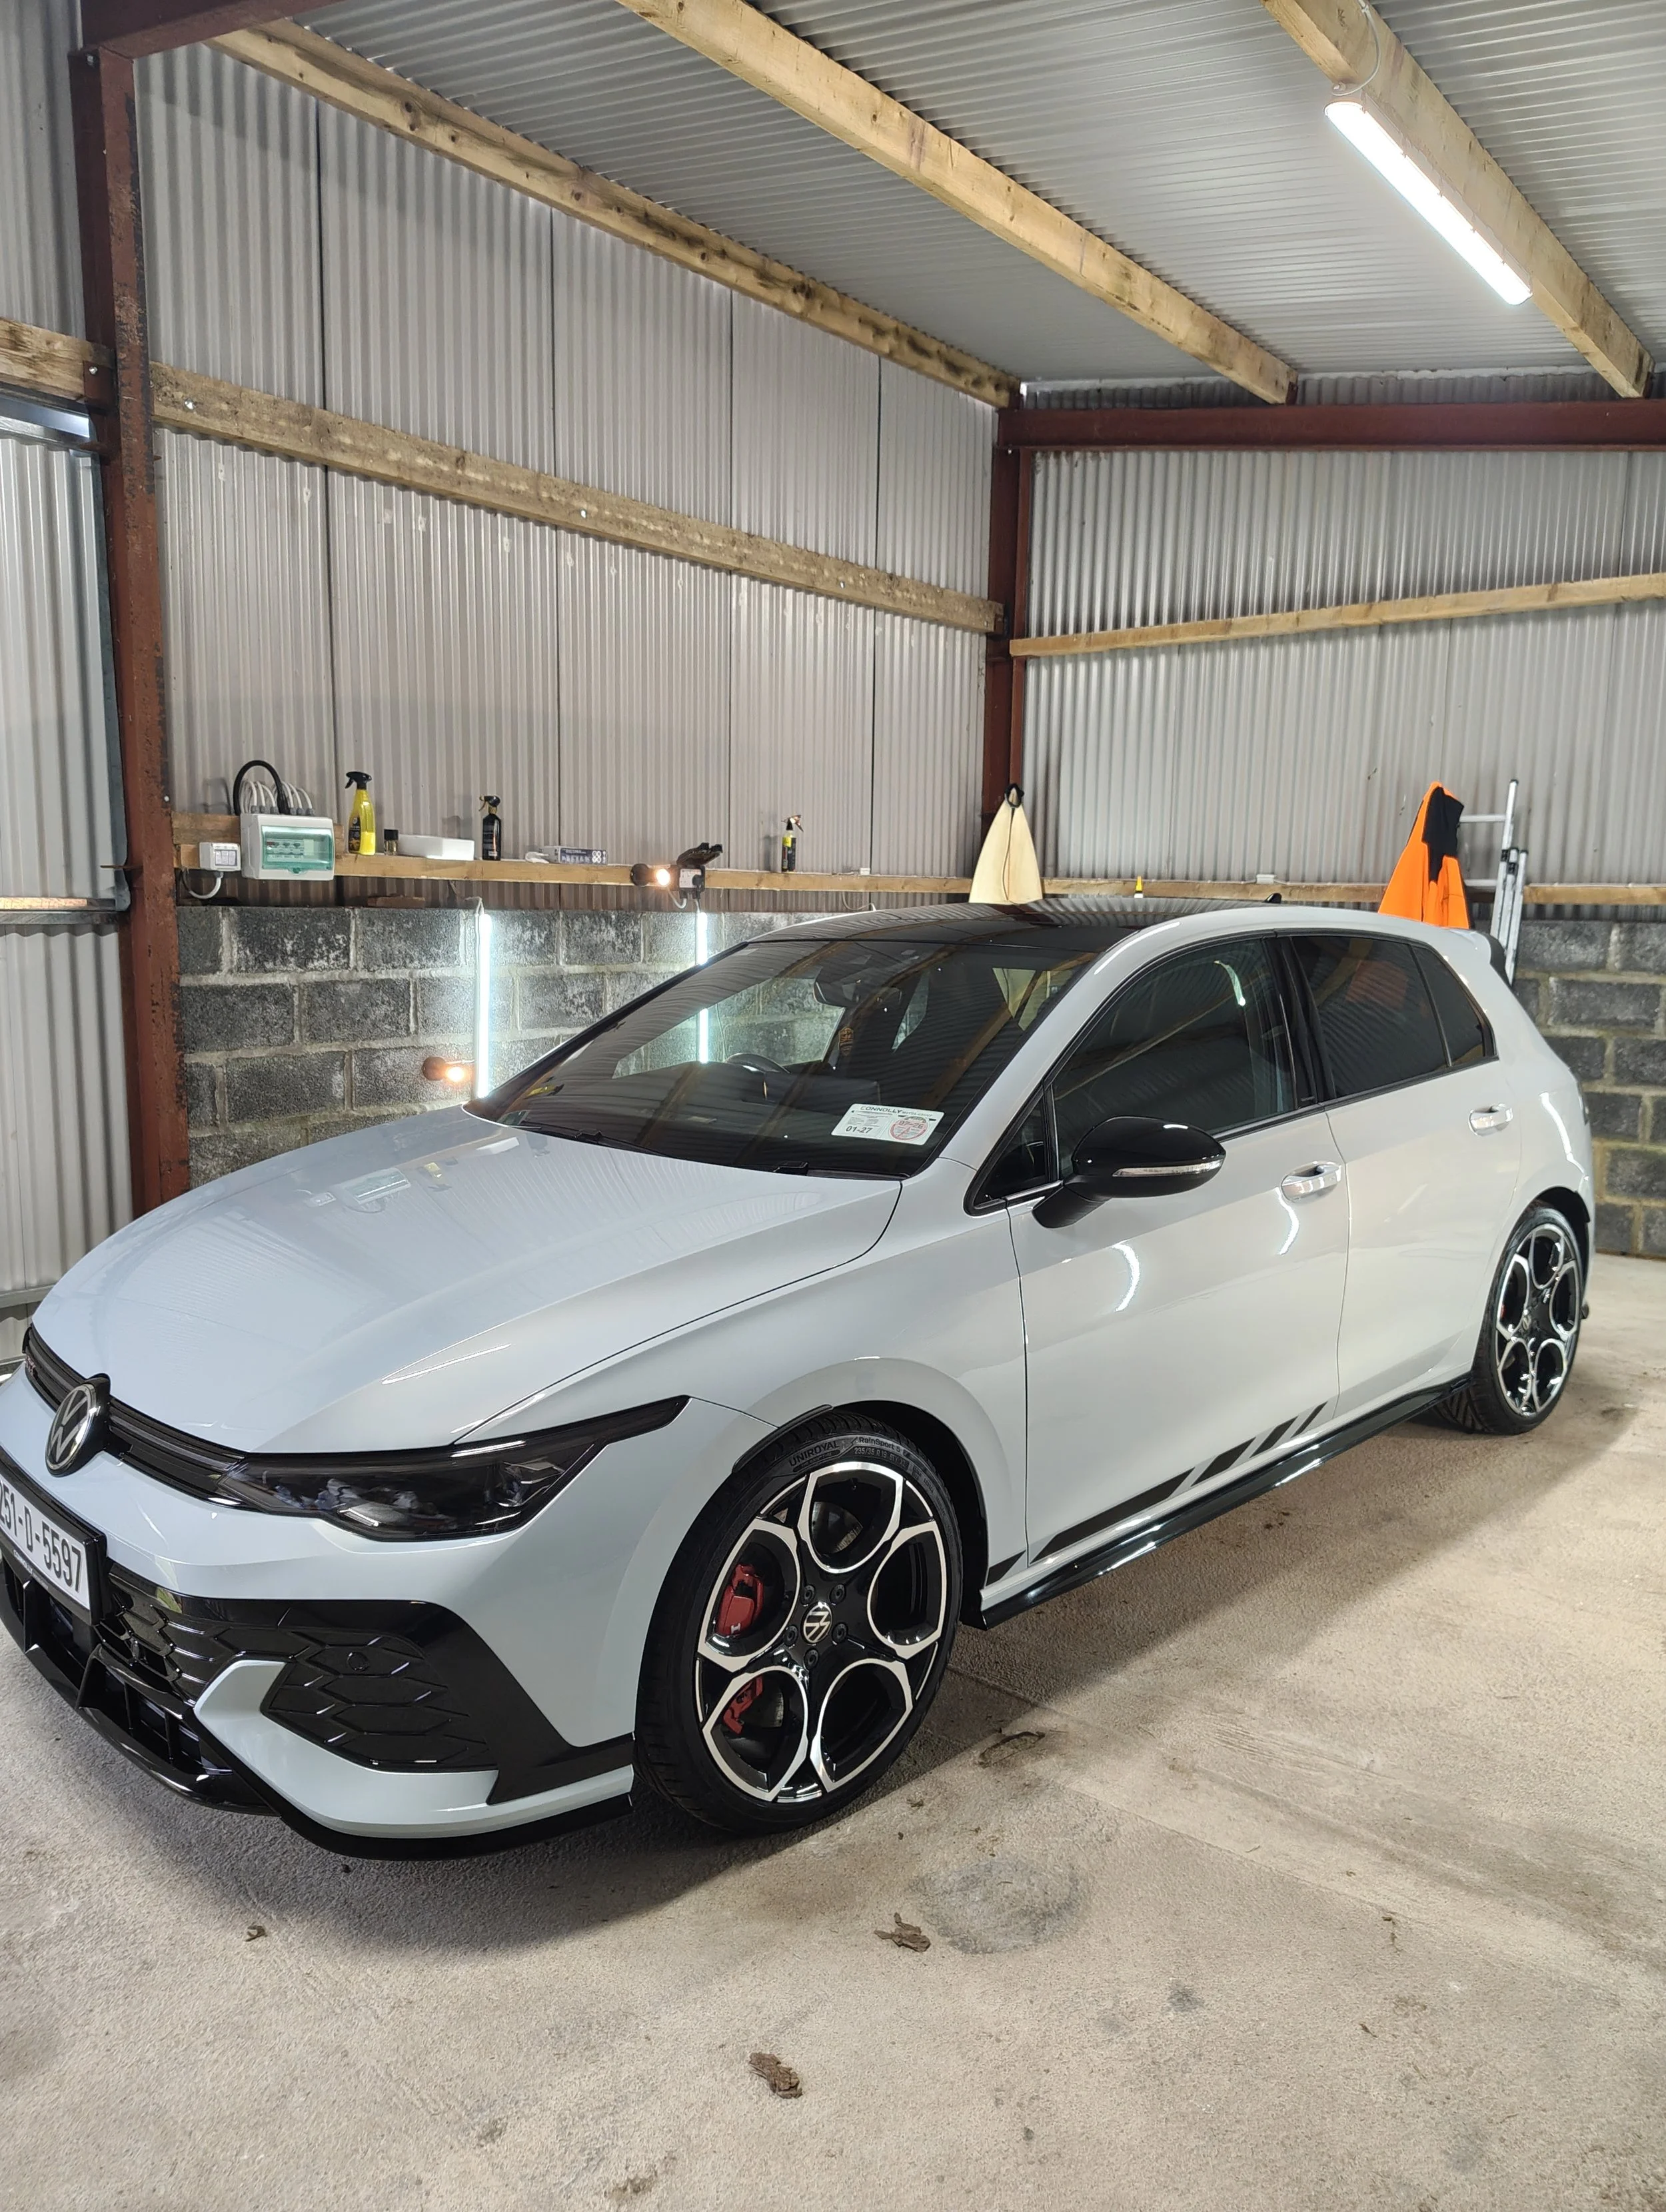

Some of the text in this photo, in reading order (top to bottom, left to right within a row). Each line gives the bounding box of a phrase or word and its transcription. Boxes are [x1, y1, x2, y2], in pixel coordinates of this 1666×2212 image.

[898, 1121, 924, 1129] 07-26
[859, 1437, 894, 1449] RainSport
[789, 1440, 840, 1467] UNIROYAL
[854, 1447, 875, 1456] 235/35
